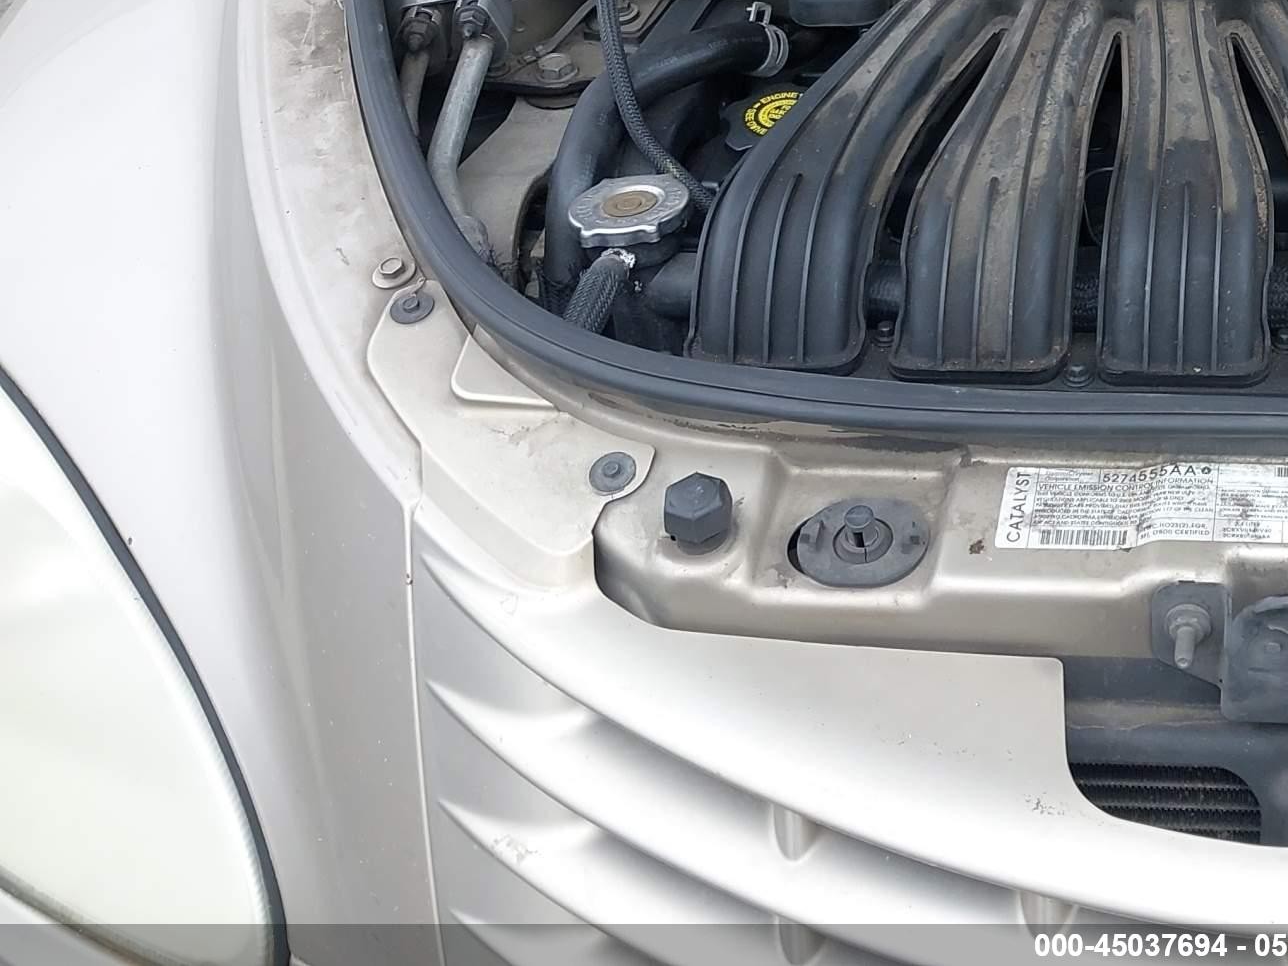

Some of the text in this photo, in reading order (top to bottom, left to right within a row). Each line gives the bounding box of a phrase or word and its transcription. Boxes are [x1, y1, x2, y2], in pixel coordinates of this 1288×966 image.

[760, 91, 799, 104] ENGINE
[1073, 484, 1114, 493] EMISSION
[1155, 477, 1214, 488] INFORMATION
[1006, 472, 1031, 543] CATALYST
